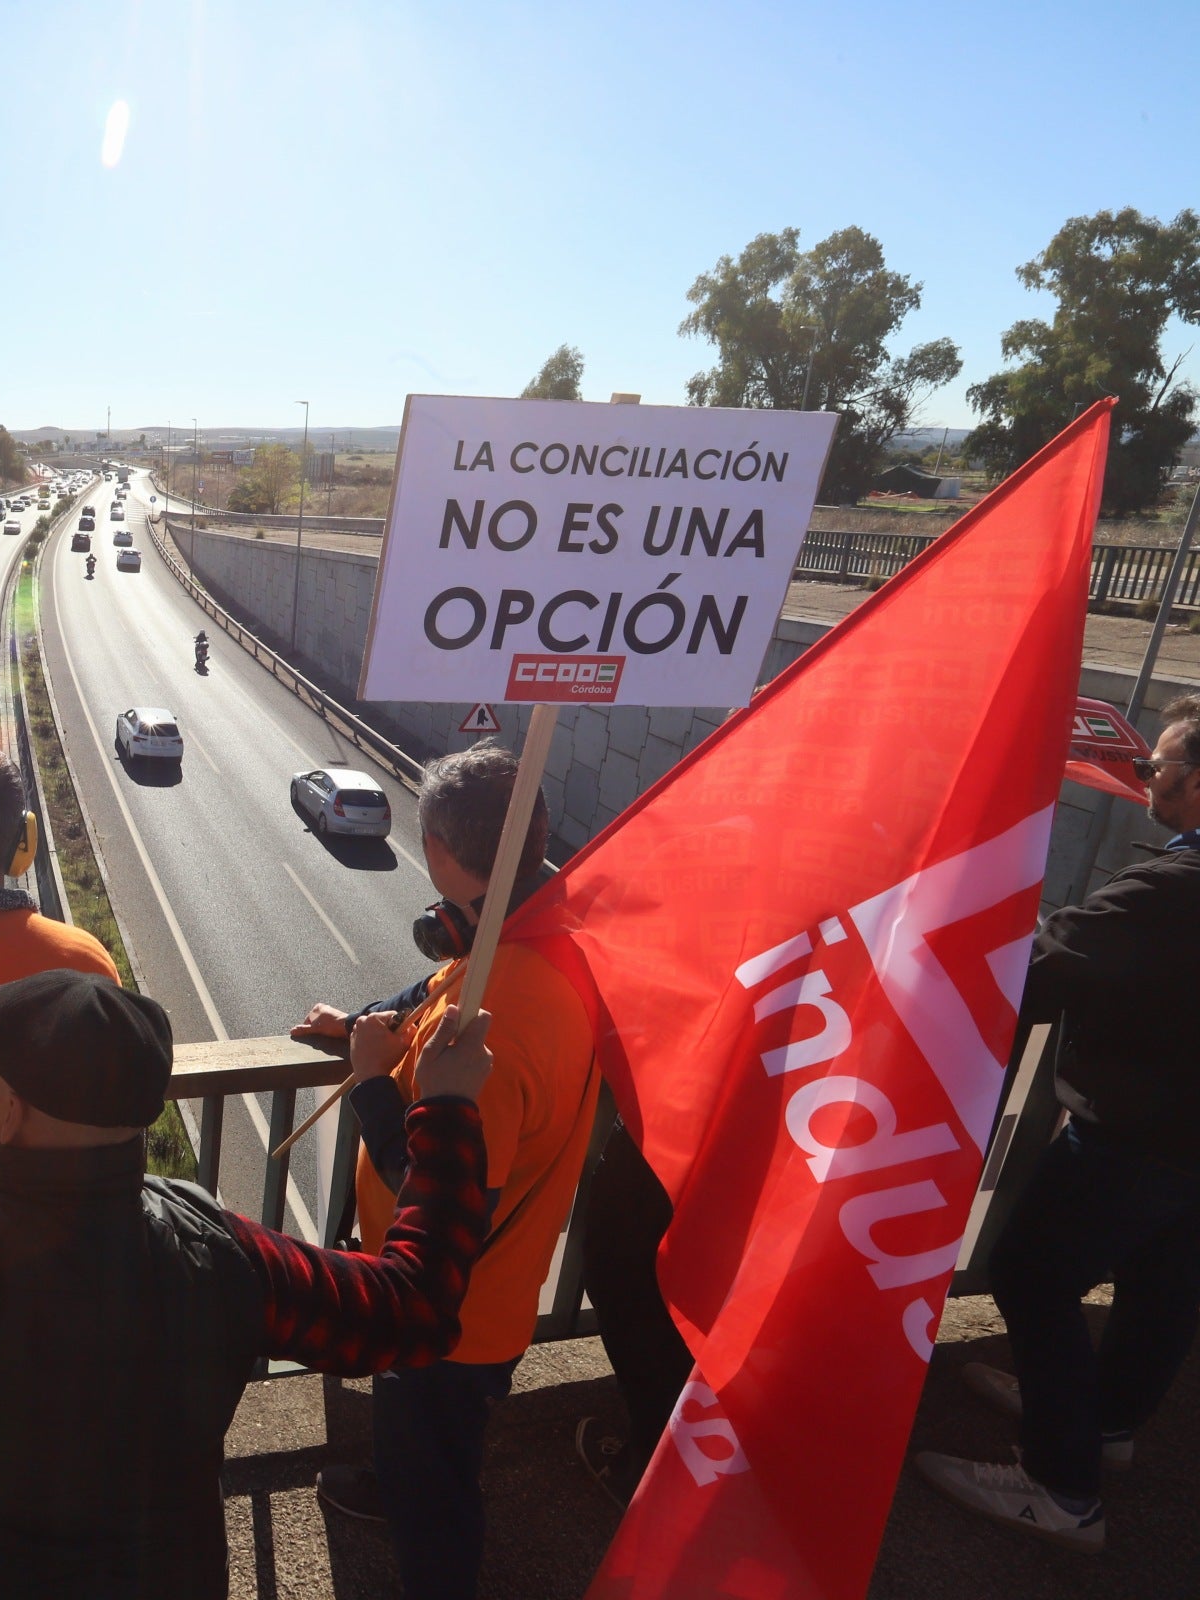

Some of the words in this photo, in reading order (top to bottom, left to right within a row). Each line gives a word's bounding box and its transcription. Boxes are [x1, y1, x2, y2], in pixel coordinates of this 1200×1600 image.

[453, 440, 495, 472] LA
[510, 441, 789, 483] CONCILIACIÓN
[438, 498, 538, 552] NO
[557, 502, 625, 555] ES
[642, 505, 765, 559] UNA
[423, 573, 749, 656] OPCIÓN
[571, 684, 612, 694] Córdoba
